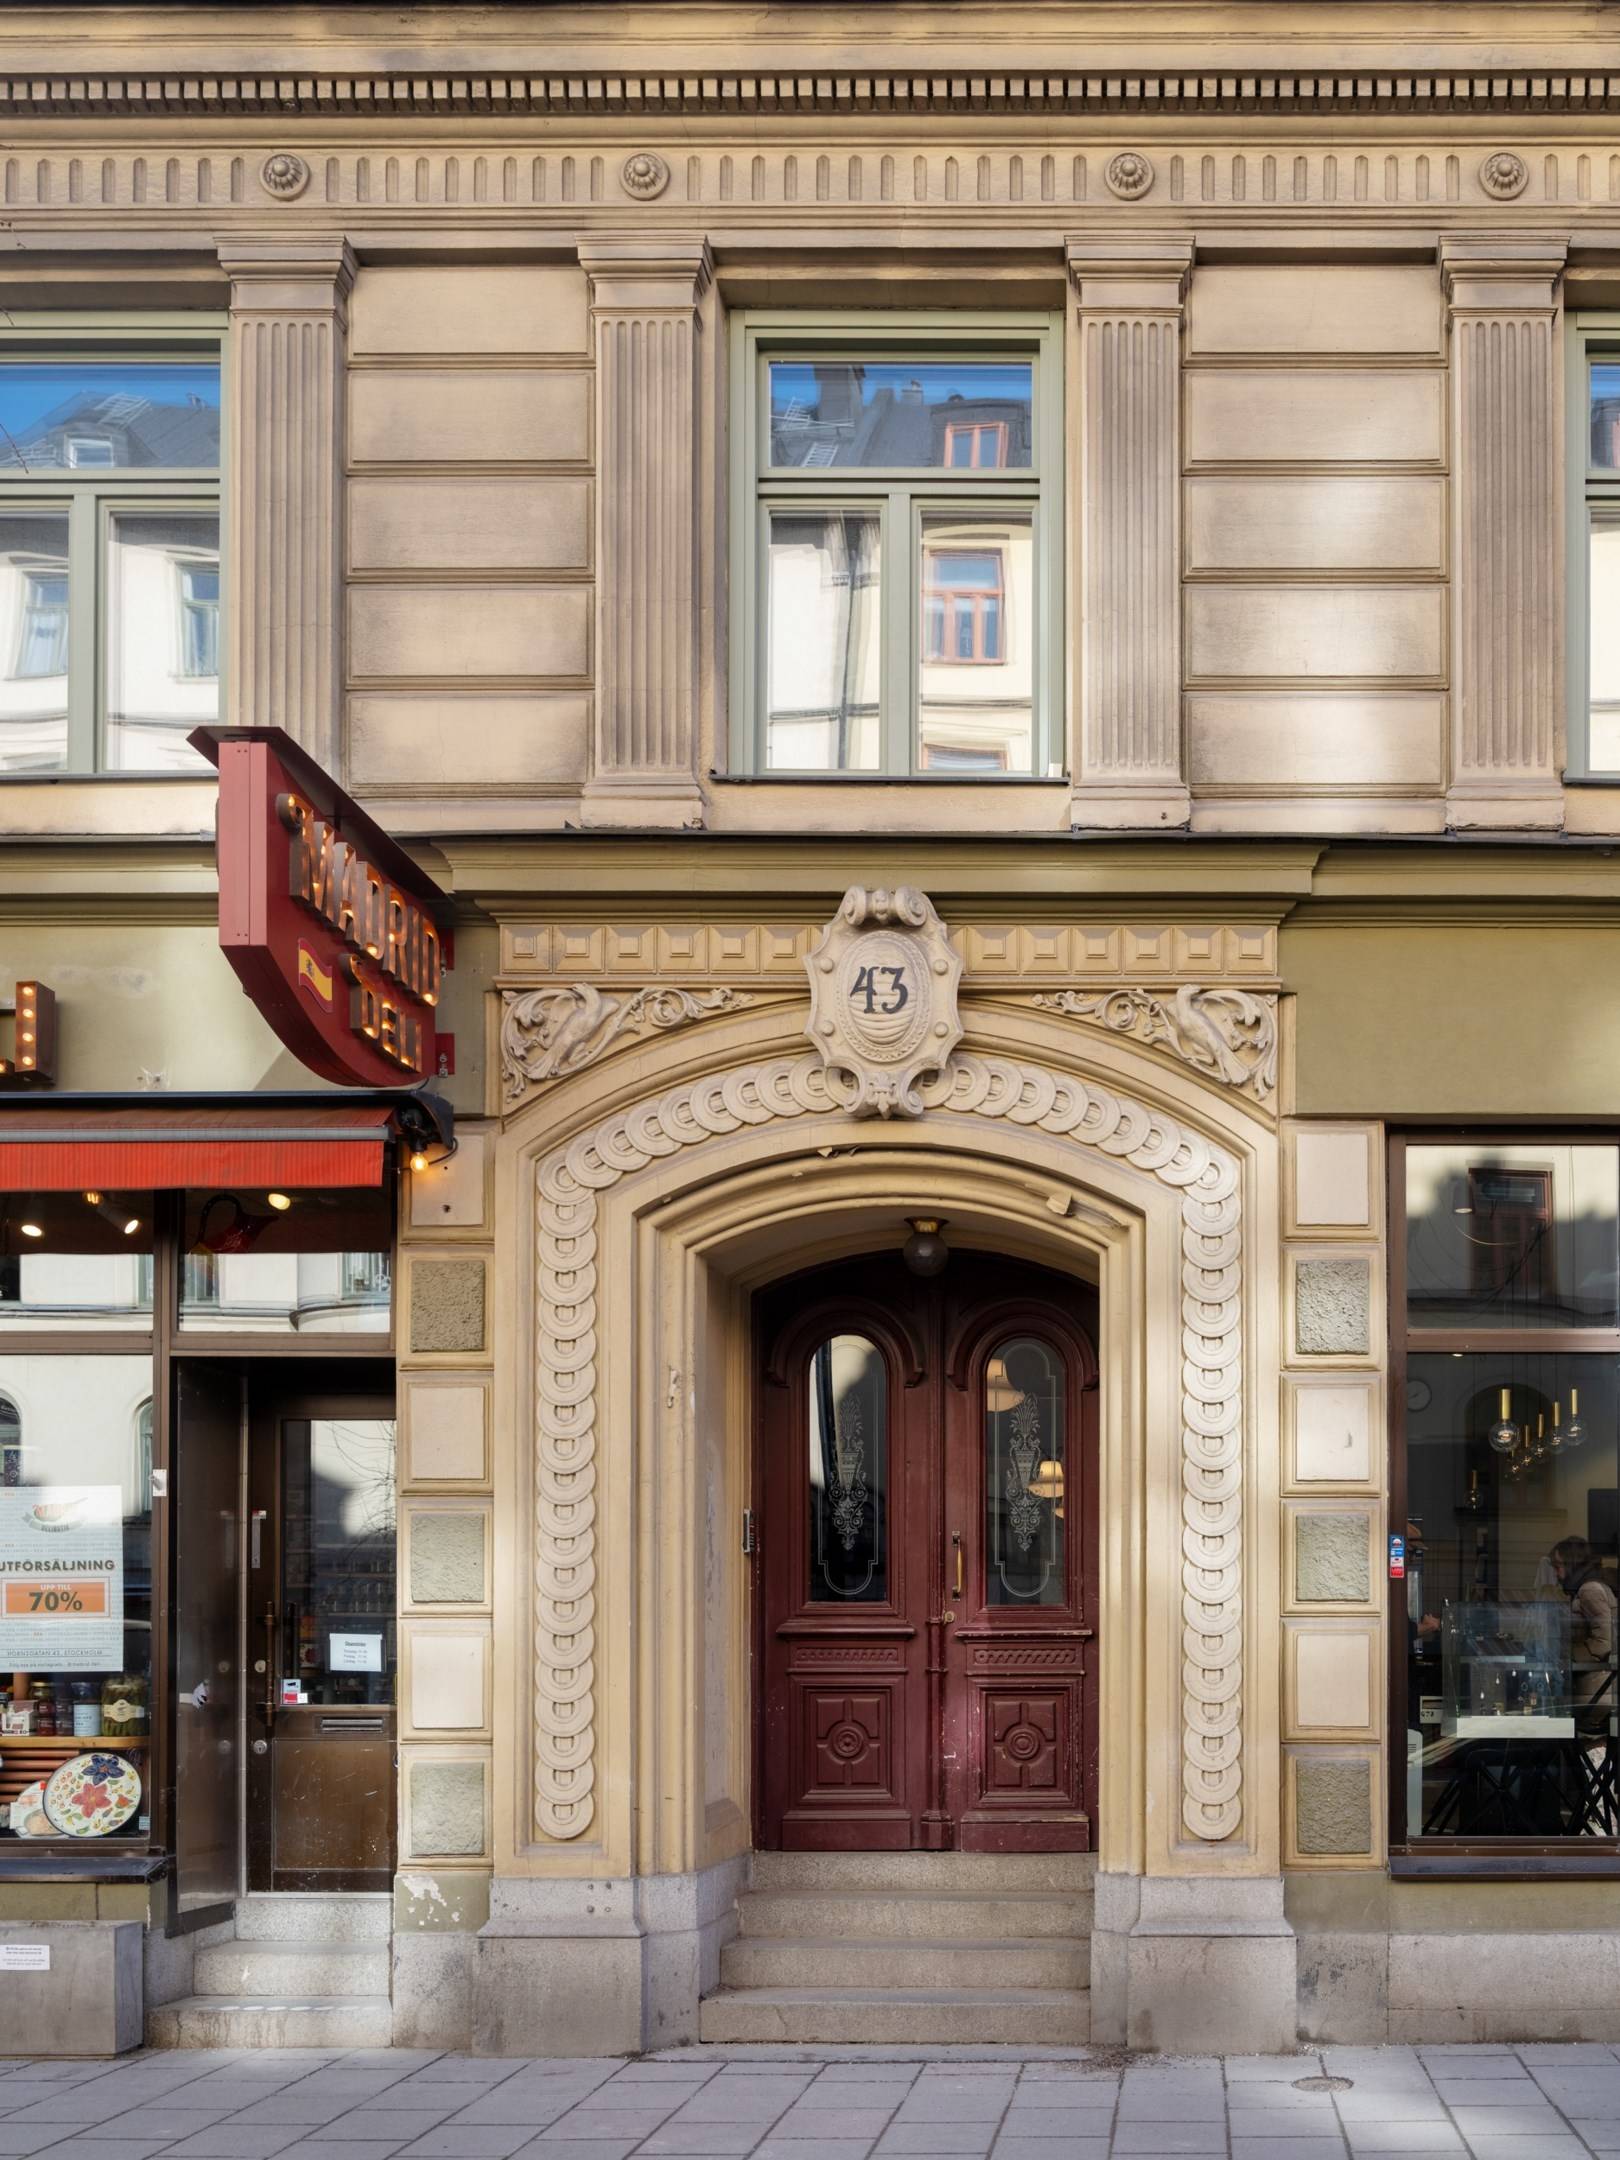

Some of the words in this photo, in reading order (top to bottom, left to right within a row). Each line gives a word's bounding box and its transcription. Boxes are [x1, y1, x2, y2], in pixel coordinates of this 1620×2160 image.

[276, 793, 441, 1007] MADRID
[339, 953, 423, 1073] DELI
[850, 966, 908, 1015] 43
[0, 1558, 115, 1572] UTFÖRSÄLJNING
[28, 1591, 83, 1612] 70%
